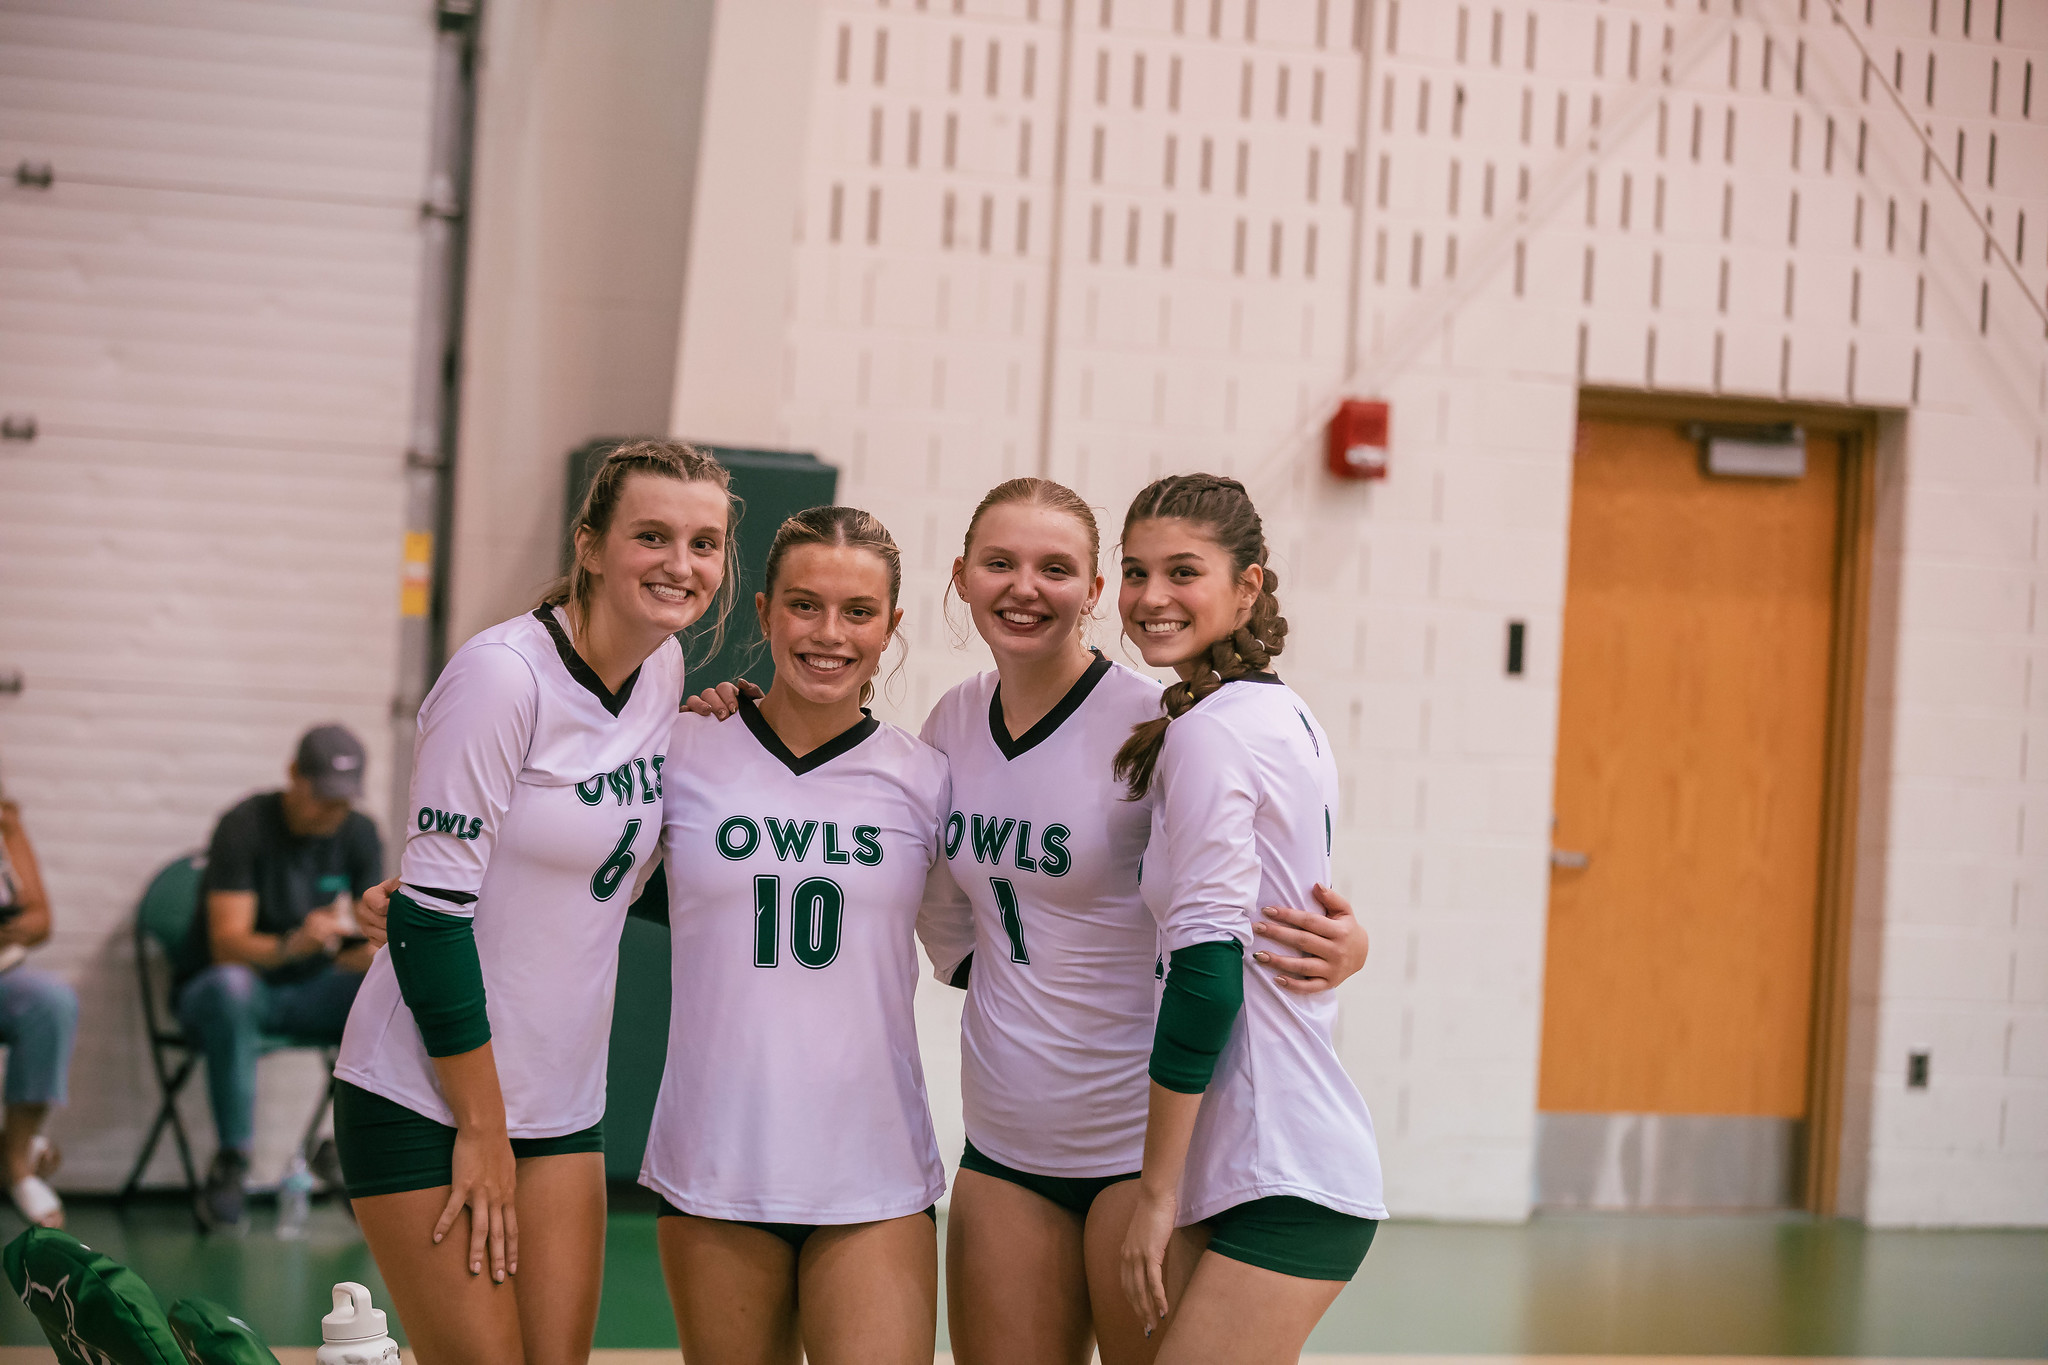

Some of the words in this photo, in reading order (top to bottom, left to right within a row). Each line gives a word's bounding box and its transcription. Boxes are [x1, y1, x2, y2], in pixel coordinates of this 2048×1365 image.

[417, 806, 484, 841] OWLS
[589, 818, 643, 903] 6
[715, 815, 884, 867] OWLS
[945, 810, 1072, 878] OWLS
[753, 874, 845, 970] 10
[988, 877, 1031, 966] 1
